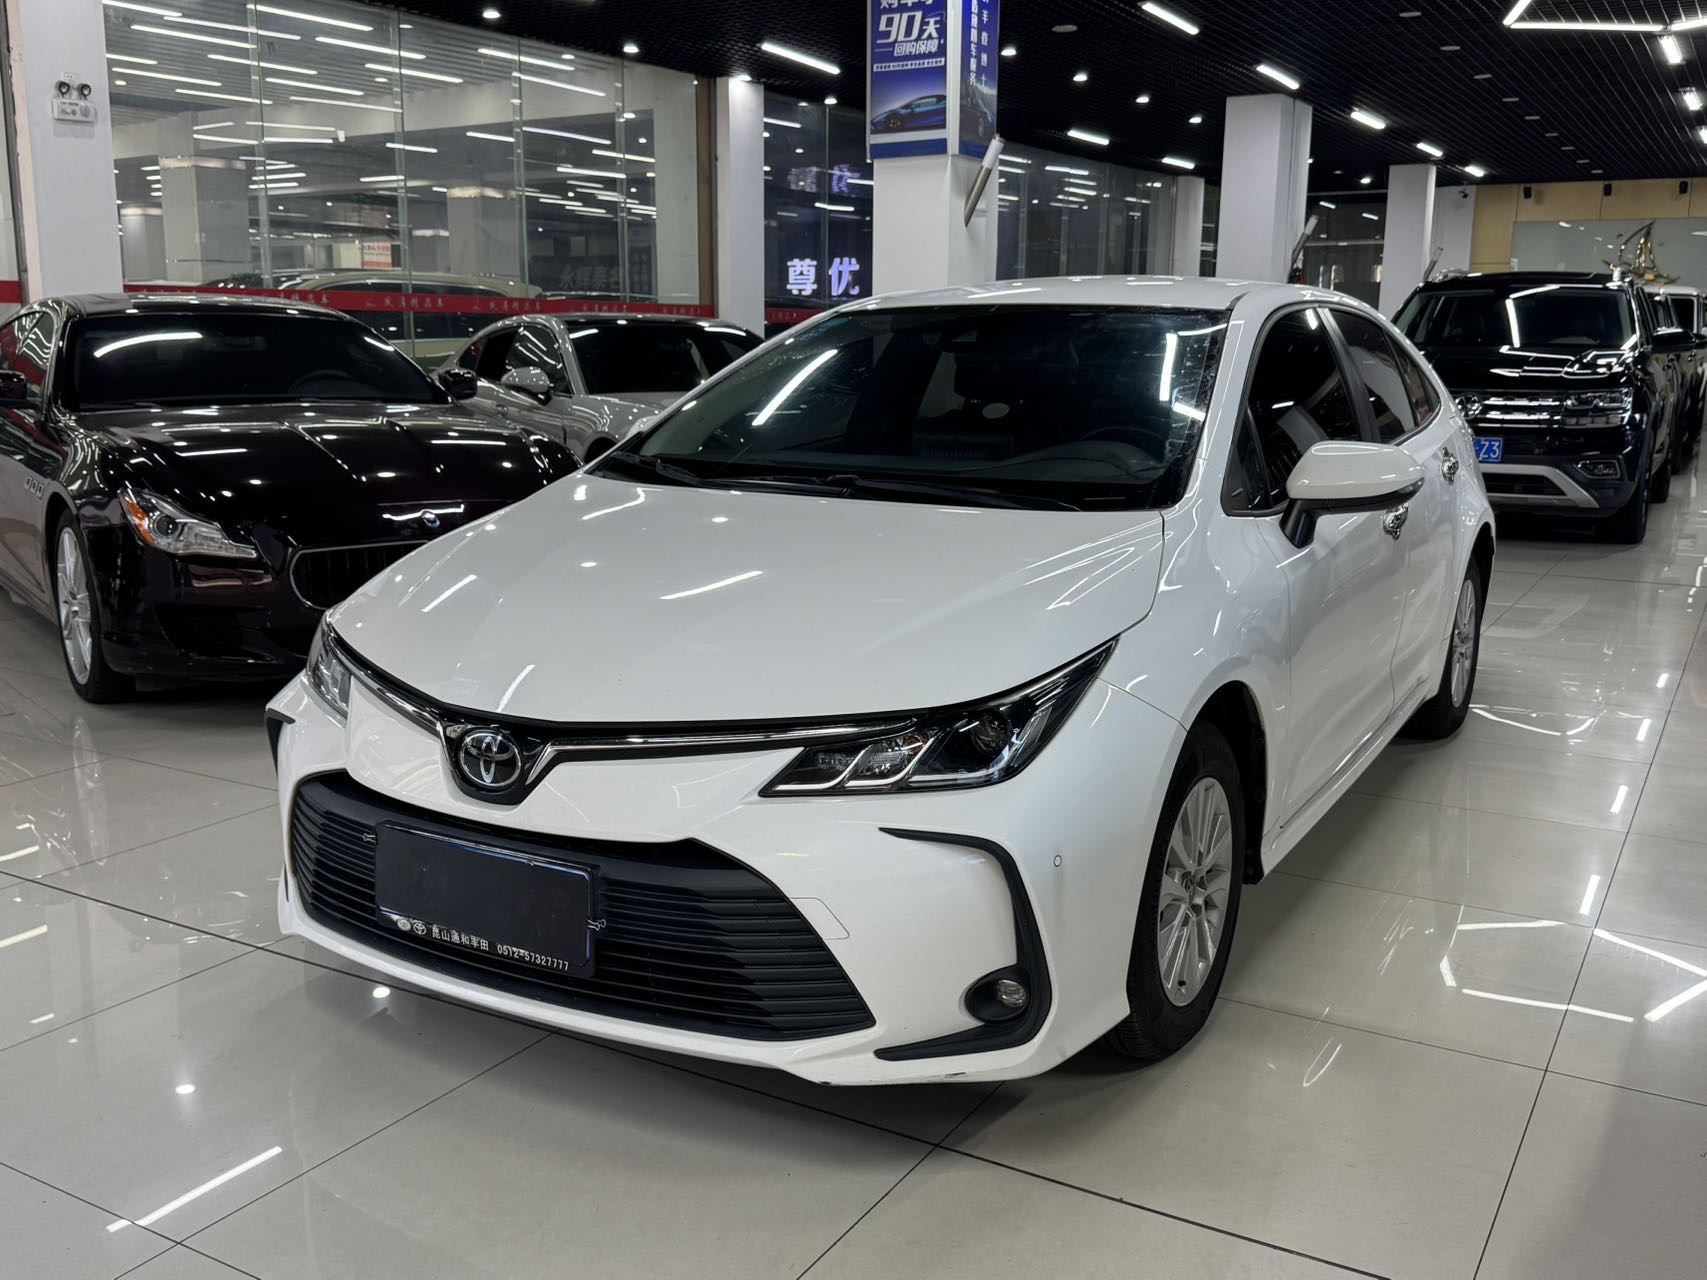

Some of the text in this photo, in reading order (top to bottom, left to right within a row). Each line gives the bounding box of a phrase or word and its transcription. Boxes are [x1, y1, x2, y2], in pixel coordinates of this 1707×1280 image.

[876, 11, 941, 44] 90天
[894, 39, 939, 56] 回购保障
[497, 944, 569, 971] 0512-57327777
